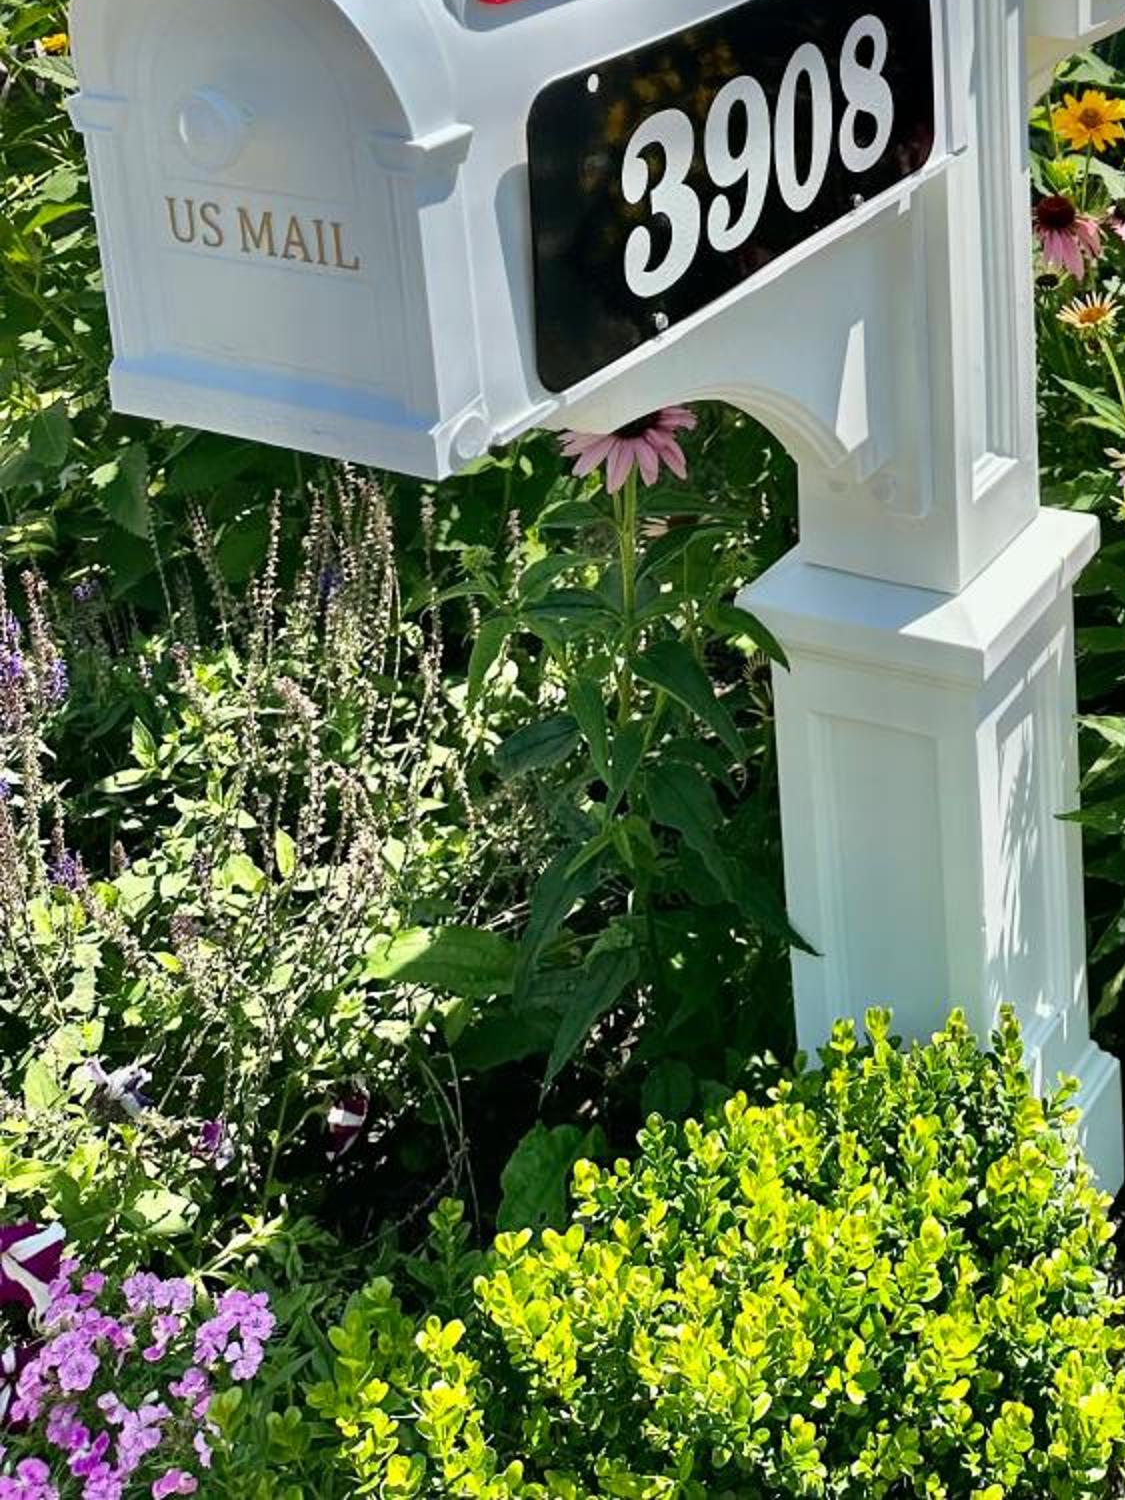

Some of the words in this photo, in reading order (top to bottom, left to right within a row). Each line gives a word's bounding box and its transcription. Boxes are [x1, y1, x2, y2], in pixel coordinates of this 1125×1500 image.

[164, 195, 224, 248] US
[236, 206, 360, 271] MAIL
[621, 13, 895, 298] 3908
